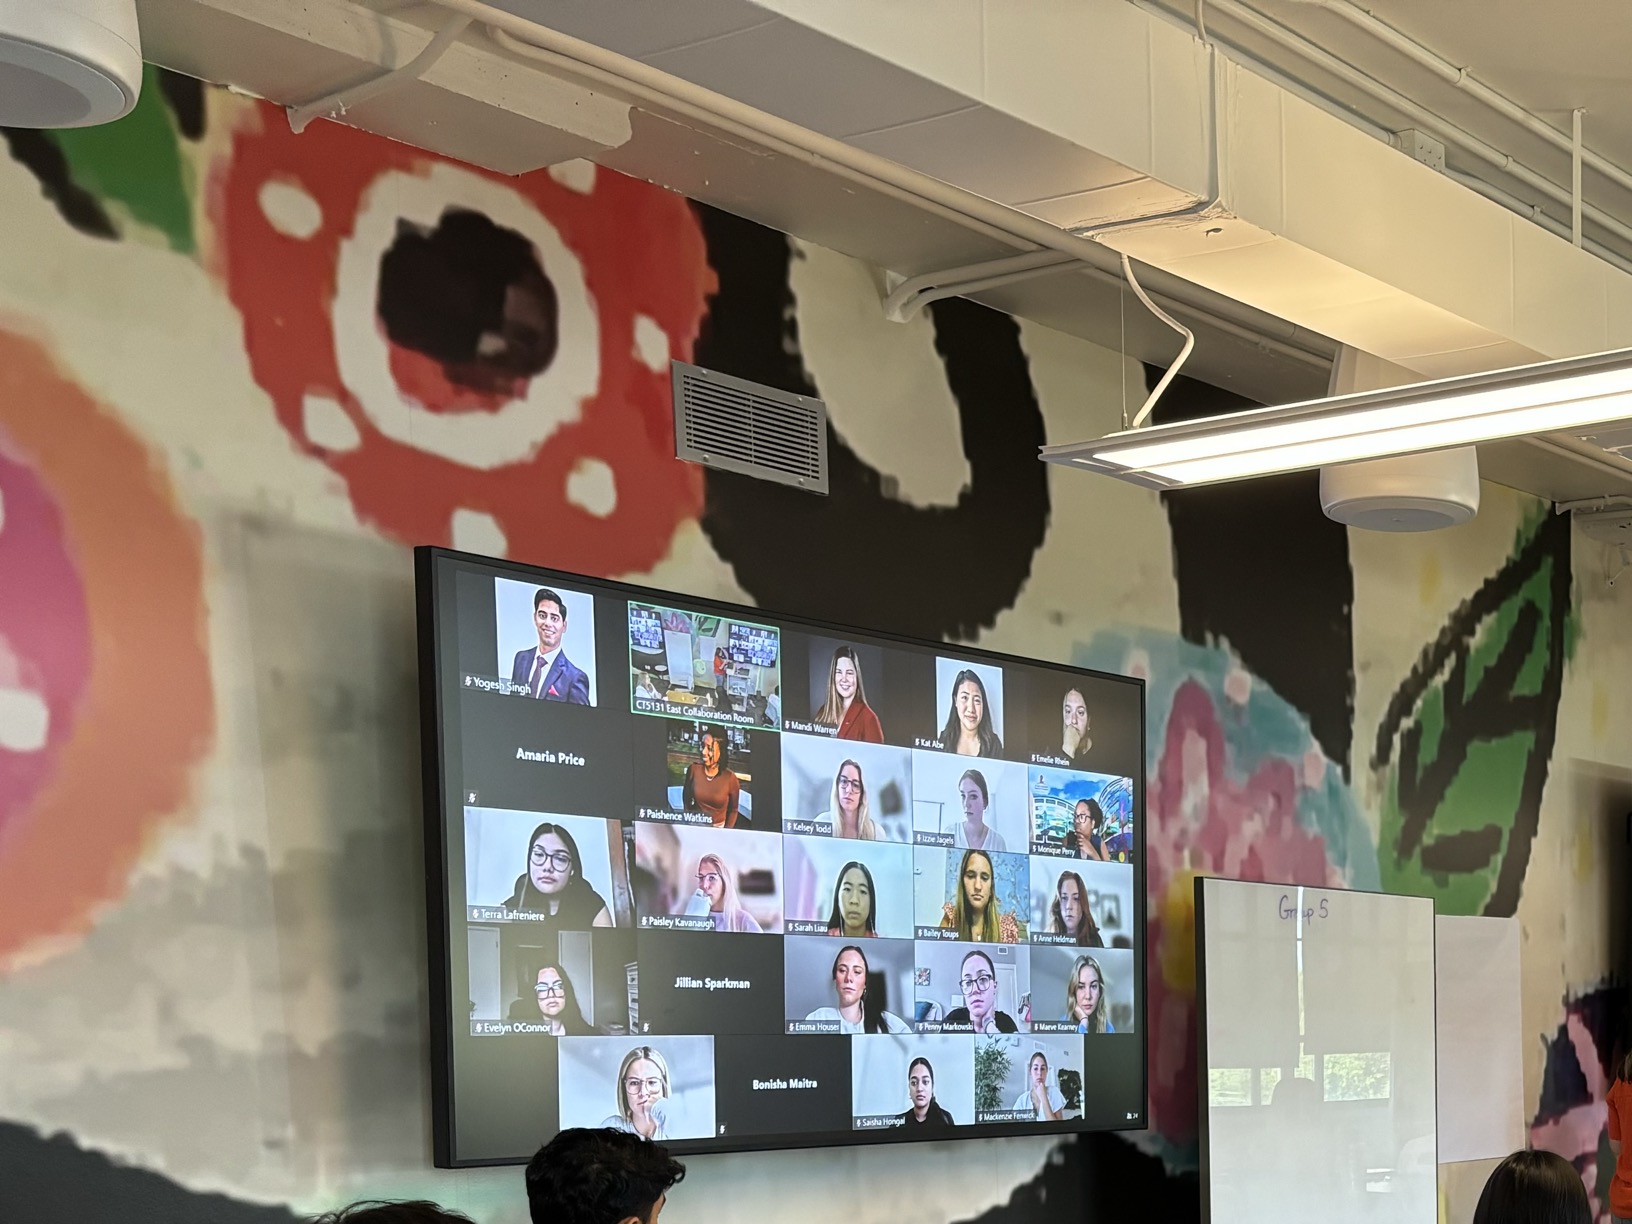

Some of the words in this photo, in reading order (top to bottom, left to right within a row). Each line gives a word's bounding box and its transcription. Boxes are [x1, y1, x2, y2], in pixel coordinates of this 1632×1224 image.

[473, 676, 504, 691] Yogesh
[506, 681, 532, 696] Singh
[636, 700, 665, 712] CT5131
[666, 703, 682, 715] East
[683, 706, 732, 721] Collaboration
[733, 713, 754, 724] Room
[791, 720, 813, 731] Mandi
[813, 724, 837, 735] Warren
[920, 738, 931, 748] Kat
[932, 740, 944, 749] Abe
[516, 747, 556, 763] Amaria
[558, 752, 586, 766] Price
[646, 810, 682, 822] Paishence
[684, 812, 712, 824] Watkins
[793, 820, 814, 834] Kelsey
[815, 823, 831, 834] Todd
[1037, 845, 1061, 855] Monique
[481, 909, 502, 920] Terra
[504, 910, 545, 921] Lafreniere
[1278, 894, 1315, 925] Grup
[1318, 897, 1329, 919] 5
[648, 916, 673, 928] Paisley
[675, 918, 715, 930] Kavanaugh
[794, 923, 813, 932] Sarah
[923, 929, 941, 939] Bailey
[1038, 934, 1052, 943] Anne
[674, 977, 703, 989] Jillian
[705, 977, 751, 992] Sparkman
[484, 1022, 512, 1034] Evelyn
[513, 1022, 551, 1033] OConnor
[795, 1023, 816, 1031] Emma
[817, 1023, 840, 1031] Houser
[924, 1022, 941, 1032] Penny
[942, 1022, 974, 1031] Markowski
[752, 1078, 788, 1090] Bonisha
[789, 1078, 818, 1089] Maitra
[984, 1111, 1012, 1121] Mackenzie
[862, 1118, 882, 1127] Saisha
